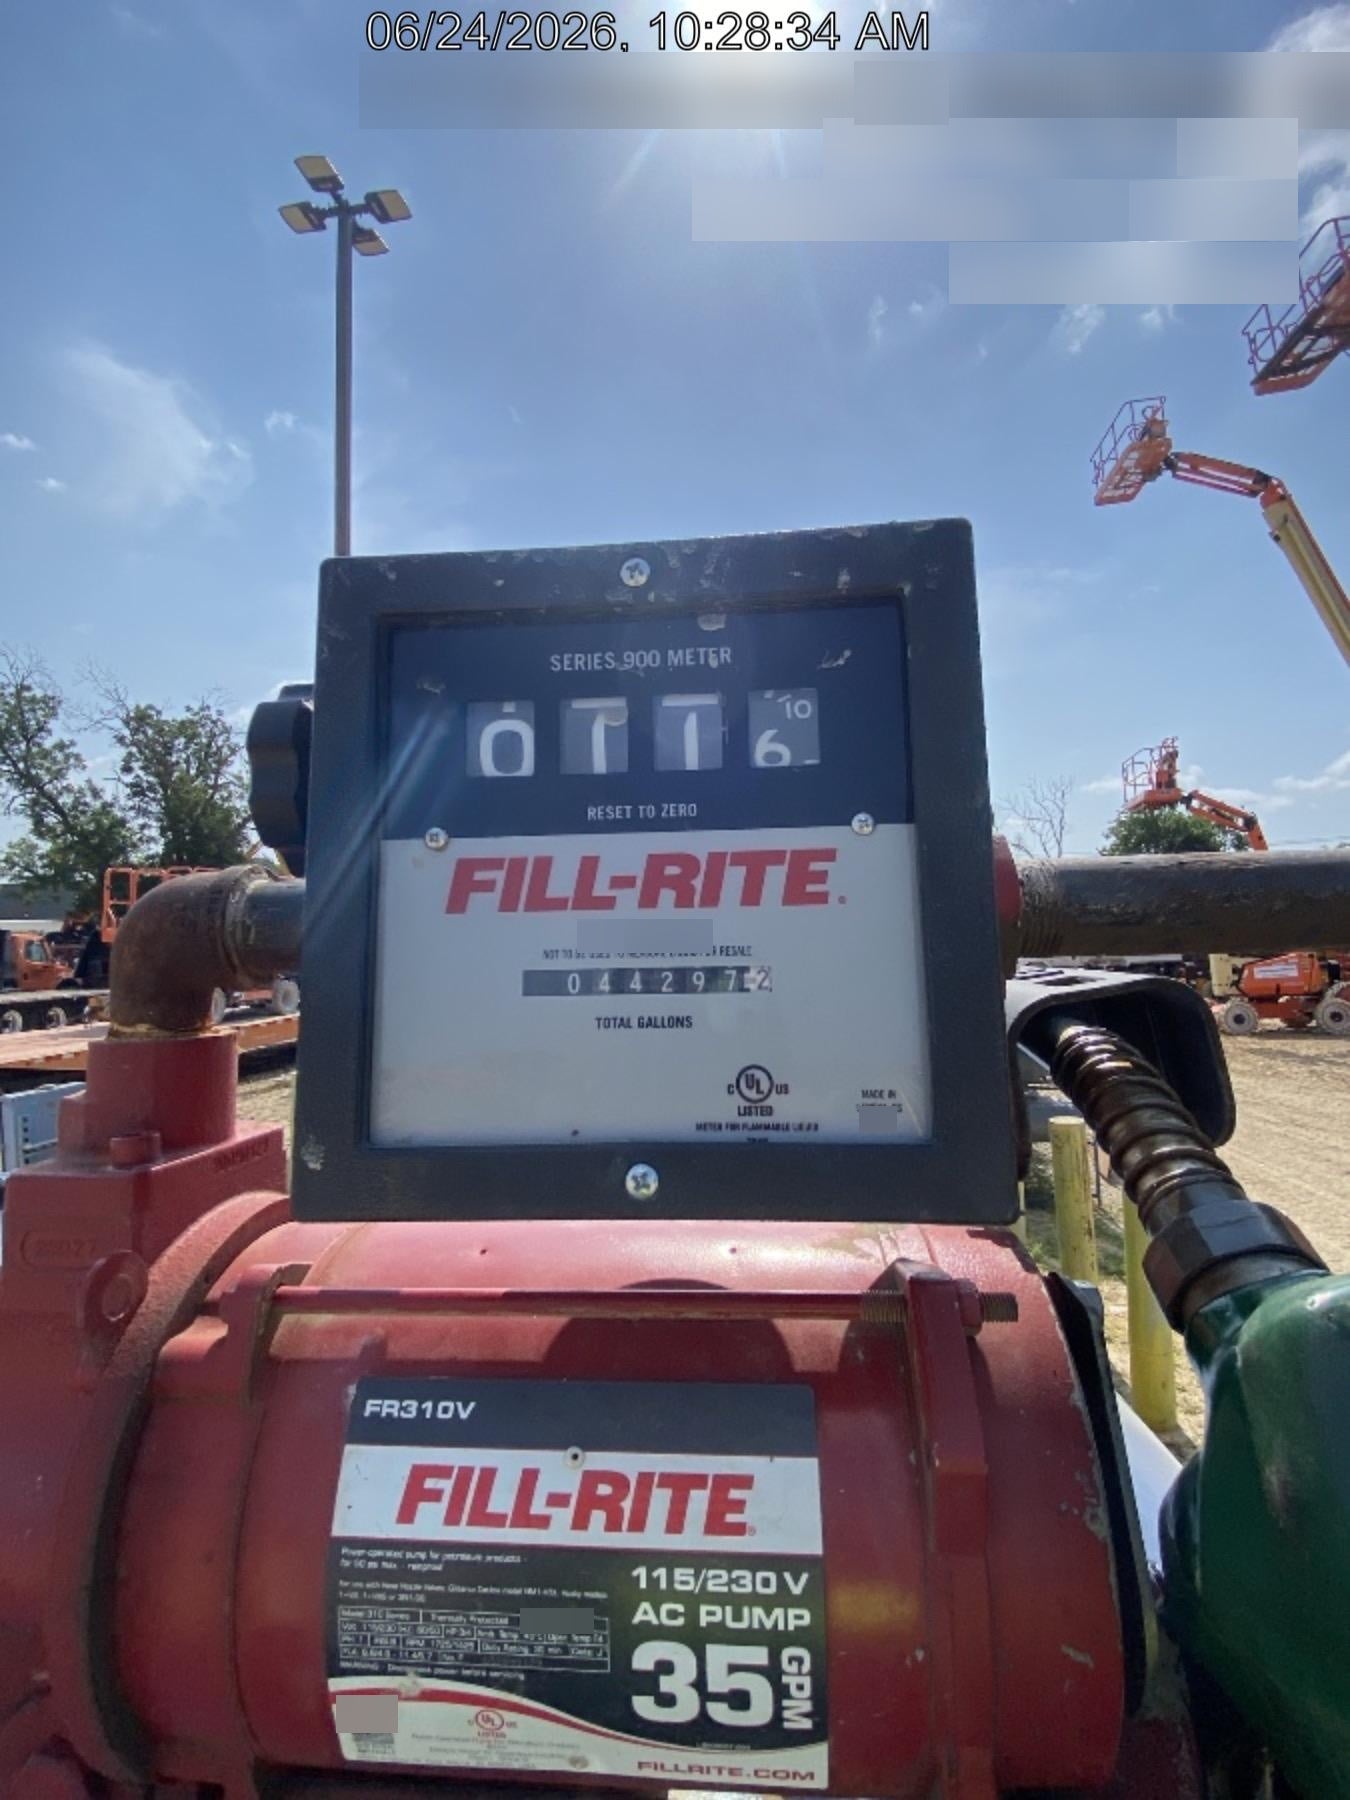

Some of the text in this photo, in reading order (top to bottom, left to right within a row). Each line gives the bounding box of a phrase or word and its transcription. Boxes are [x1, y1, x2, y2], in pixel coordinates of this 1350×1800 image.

[550, 647, 732, 671] SERIES 900 METER
[587, 803, 697, 821] RESET TO ZERO
[595, 1016, 693, 1030] TOTAL GALLONS
[737, 1105, 774, 1117] LISTED
[364, 1399, 475, 1419] FR310V
[631, 1565, 777, 1594] 115/230
[782, 1571, 809, 1595] V
[631, 1601, 811, 1631] AC PUMP
[631, 1640, 774, 1727] 35
[781, 1646, 813, 1730] GPM
[637, 1760, 815, 1781] FILLRITE.COM
